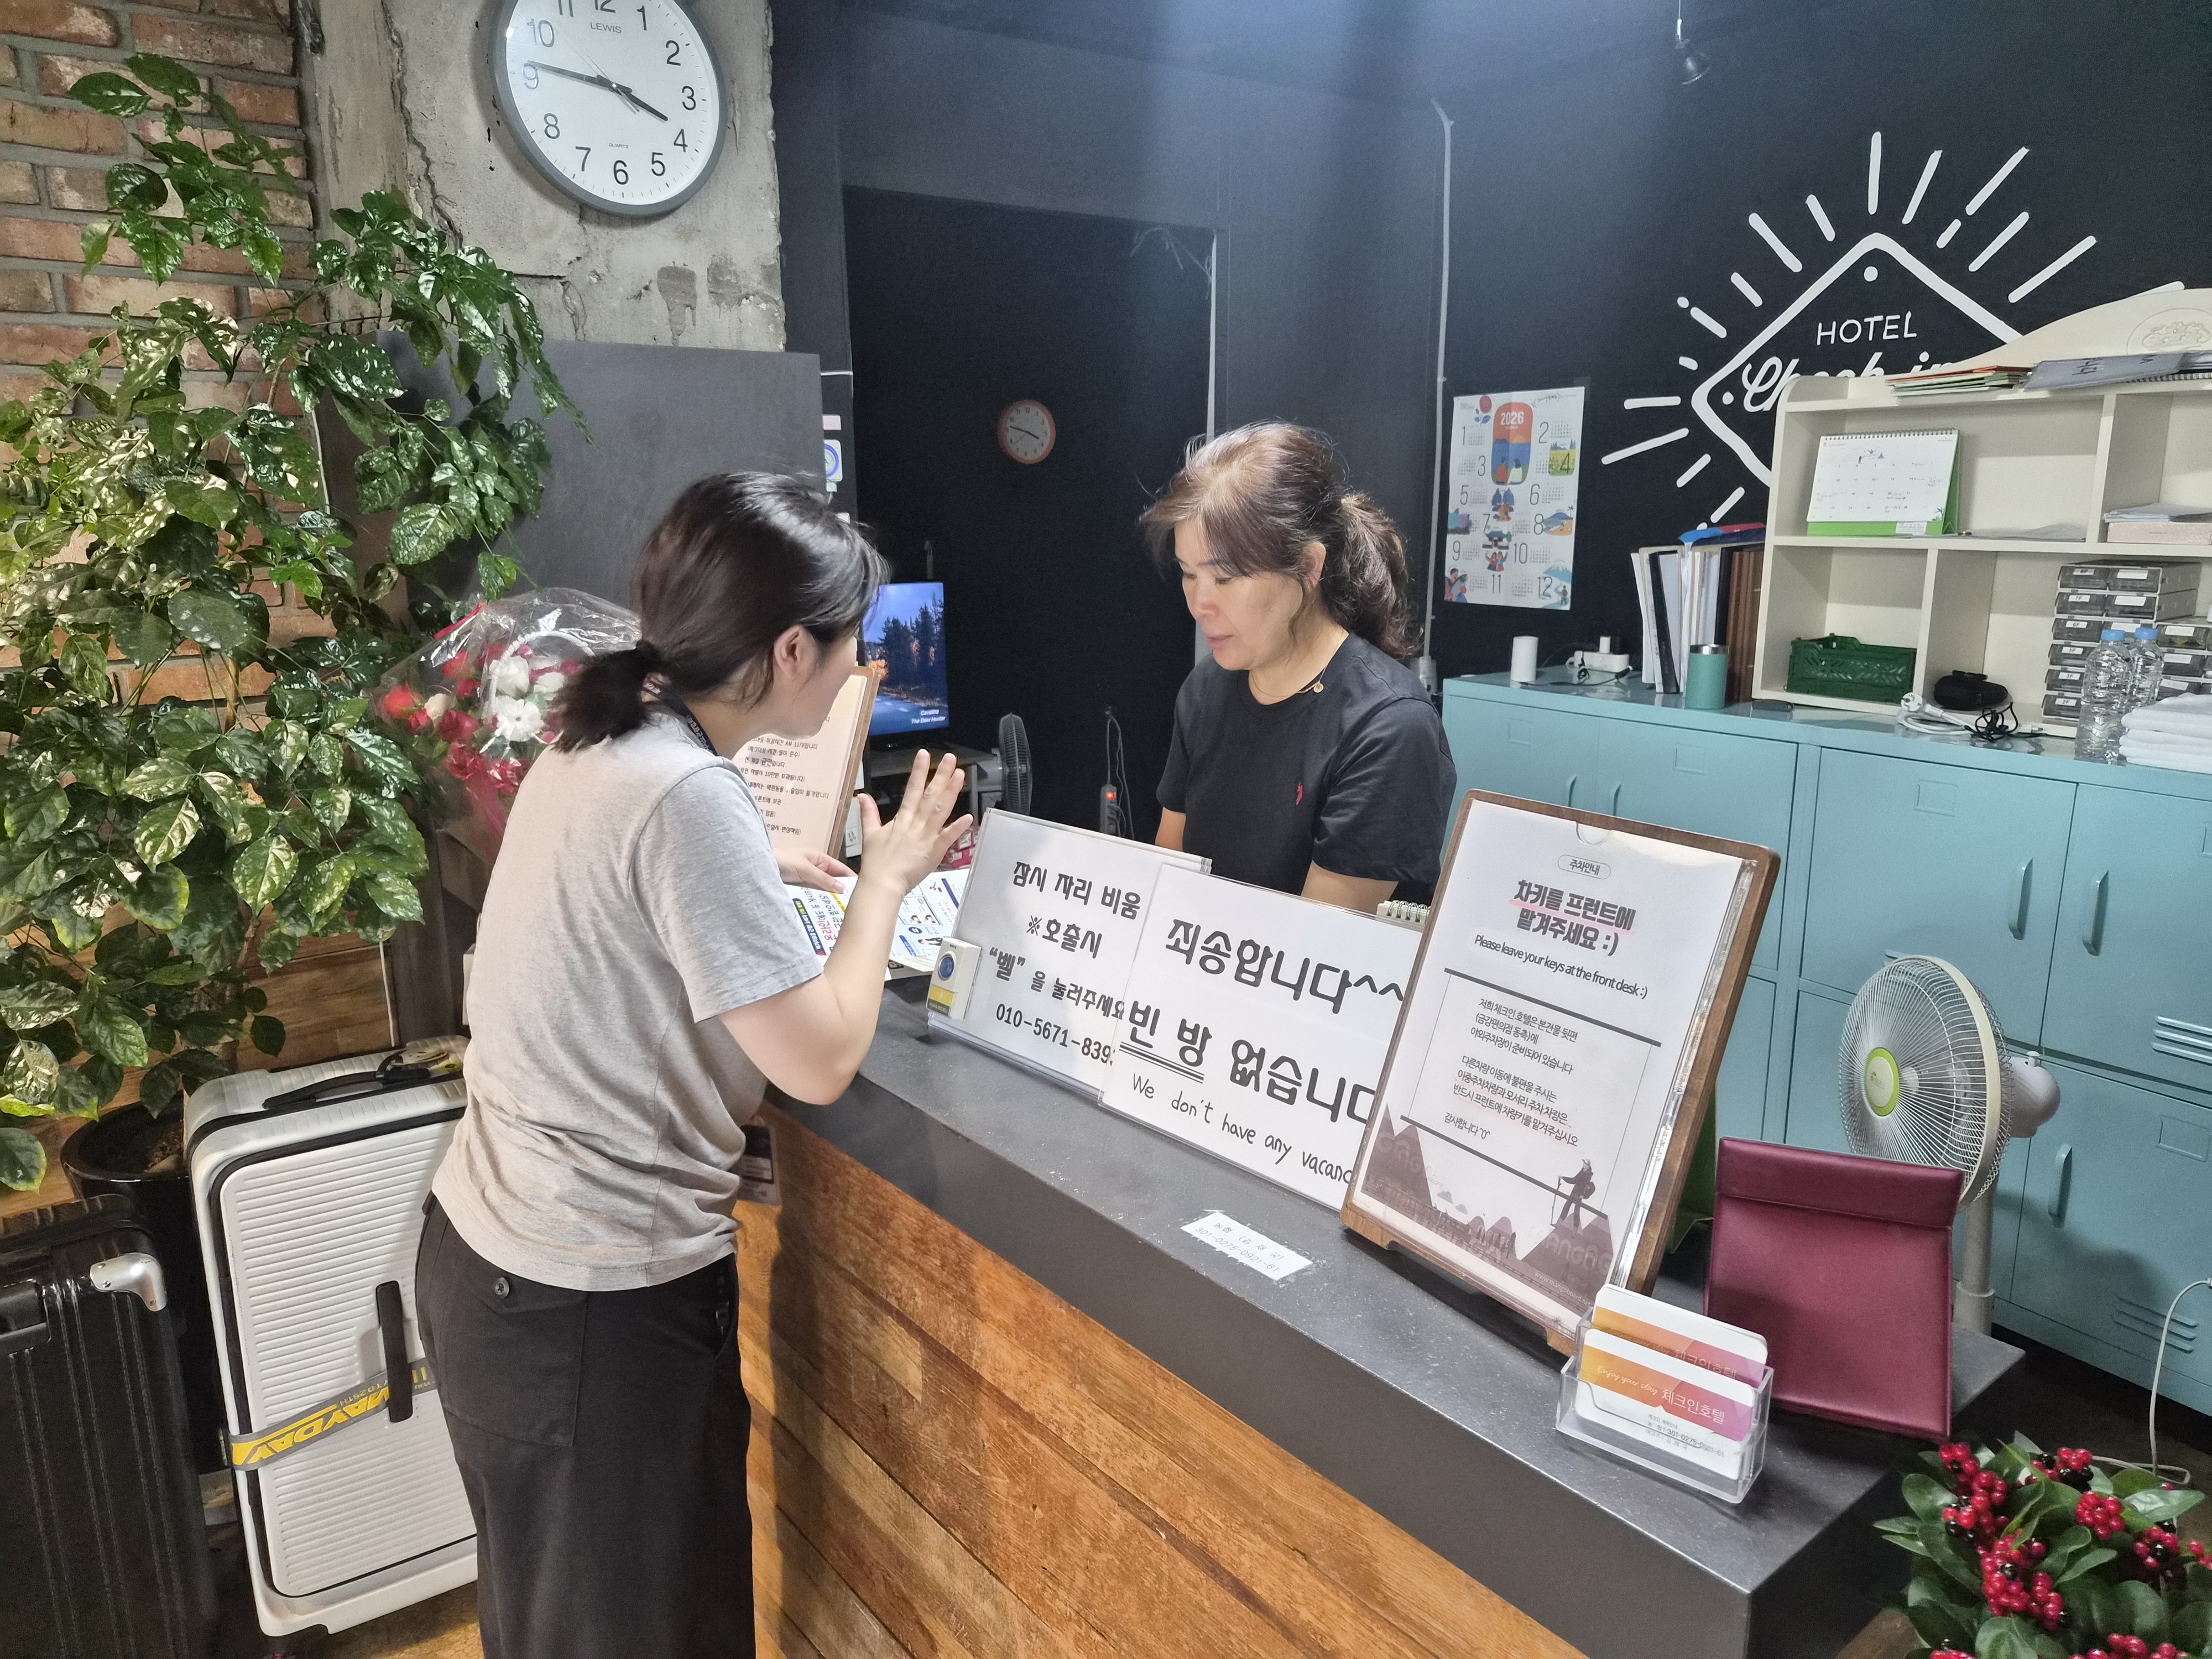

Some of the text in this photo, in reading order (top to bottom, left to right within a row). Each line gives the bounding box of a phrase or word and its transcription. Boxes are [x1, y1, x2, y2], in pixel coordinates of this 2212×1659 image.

[590, 22, 622, 33] LEWIS
[637, 6, 647, 31] 1
[526, 18, 555, 48] 10
[665, 40, 681, 66] 2
[521, 62, 539, 90] 9
[681, 85, 697, 111] 3
[544, 113, 561, 139] 8
[674, 128, 688, 153] 4
[575, 145, 591, 172] 7
[651, 152, 666, 176] 5
[613, 160, 629, 185] 6
[1815, 311, 1917, 346] HOTEL
[1500, 411, 1524, 426] 2026
[1462, 426, 1466, 446] 1
[1538, 421, 1549, 444] 2
[1477, 455, 1486, 476] 3
[1560, 452, 1571, 474] 4
[1460, 485, 1469, 505] 5
[1530, 484, 1540, 505] 6
[1483, 513, 1490, 534] 7
[1533, 513, 1543, 535] 8
[1452, 540, 1460, 561] 9
[1514, 542, 1528, 564] 10
[1491, 574, 1501, 594] 11
[1537, 576, 1553, 598] 12
[1569, 859, 1600, 875] 주차안내
[1013, 861, 1141, 920] 잠시 자리 비움
[1514, 879, 1636, 931] 차키를 프런트에
[1516, 907, 1600, 951] 맡겨주세요
[1475, 934, 1501, 952] Please
[1501, 942, 1524, 959] leave
[1522, 951, 1545, 965] your
[1544, 956, 1566, 973] keys
[1565, 965, 1576, 976] at
[1575, 966, 1592, 980] the
[1592, 971, 1617, 989] front
[1616, 979, 1640, 997] desk
[1031, 971, 1046, 992] 을
[1052, 978, 1125, 1021] 눌러주세요
[1129, 1000, 1161, 1049] 빈
[1177, 1019, 1213, 1067] 방
[1475, 1013, 1539, 1045] (금강편의점 동측)에
[1479, 998, 1578, 1043] 저희 체크인 호텔은 본건물 뒷편
[996, 1003, 1116, 1066] 010-5671-839
[1470, 1027, 1573, 1075] 야외주차장이 준비되어 있습니다
[1462, 1055, 1558, 1103] 다른차량 이동에 불편을 주시는
[1457, 1070, 1568, 1125] 이중주차차량과 모서리 주차 차량은
[1444, 1112, 1479, 1136] 감사합니다
[1453, 1083, 1578, 1147] 반드시 프런트에 차량키를 맡겨주십시오
[1131, 1074, 1155, 1099] We
[1172, 1091, 1214, 1124] don't
[1222, 1114, 1257, 1145] have
[1265, 1135, 1292, 1165] any
[1302, 1151, 1353, 1185] vacanc
[1195, 1227, 1280, 1272] 301-0275-0921-61
[1597, 1365, 1725, 1425] Enjoy your stay 체크인호텔
